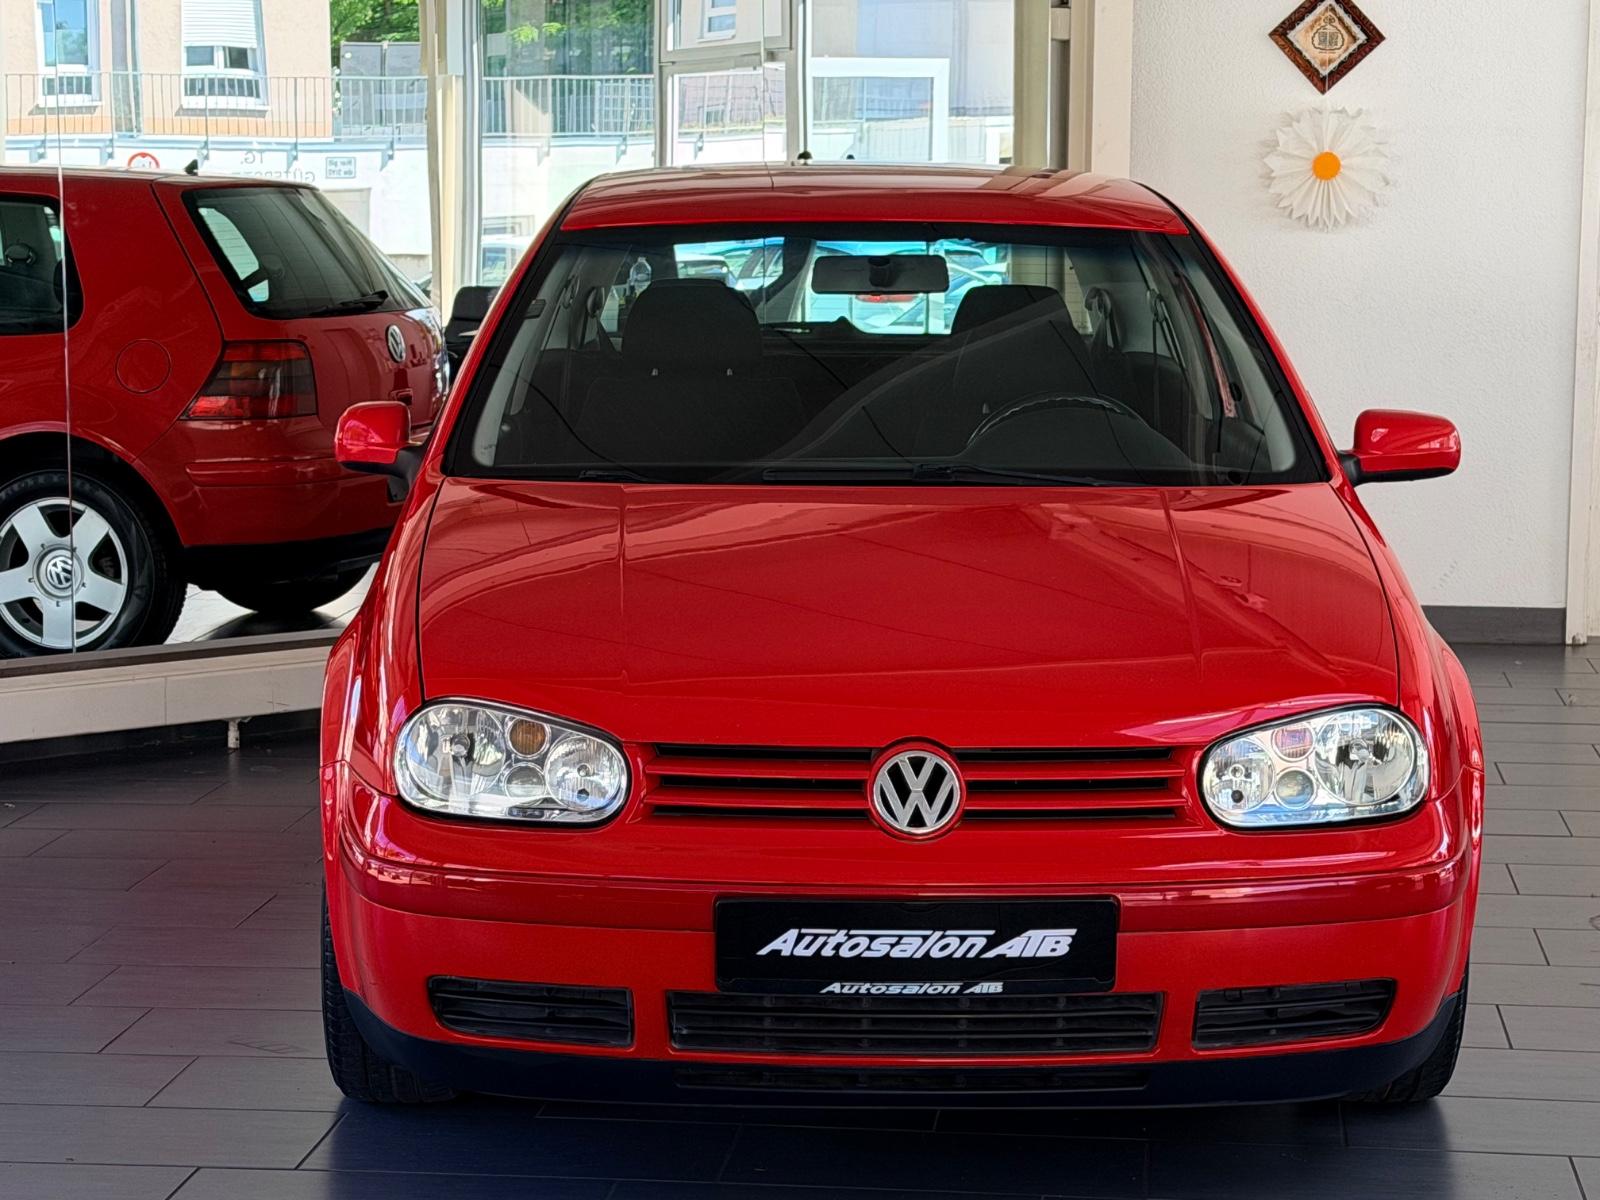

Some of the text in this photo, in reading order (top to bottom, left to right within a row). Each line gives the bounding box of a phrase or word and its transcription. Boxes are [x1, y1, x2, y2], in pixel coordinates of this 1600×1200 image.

[874, 750, 960, 834] VW
[756, 928, 1078, 958] Autosalon ATB
[819, 982, 1004, 994] Autosalon ATB
